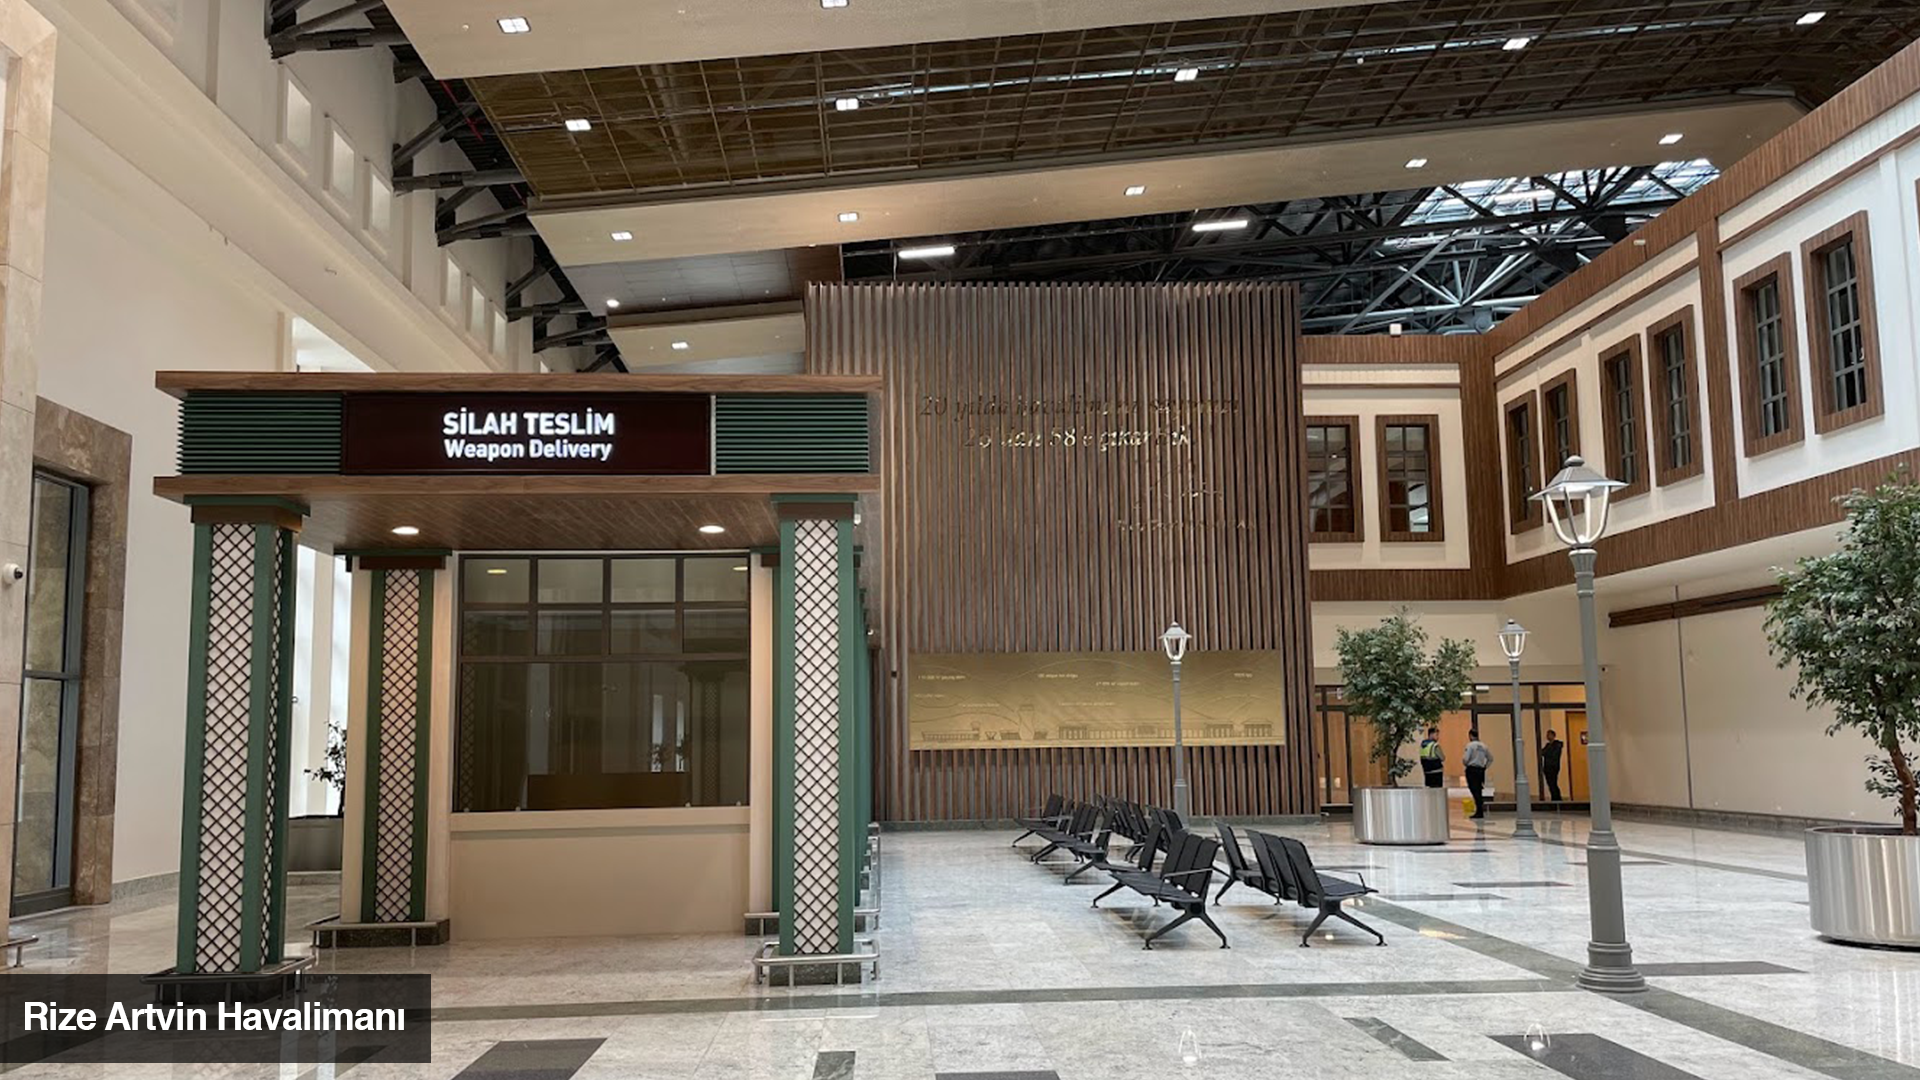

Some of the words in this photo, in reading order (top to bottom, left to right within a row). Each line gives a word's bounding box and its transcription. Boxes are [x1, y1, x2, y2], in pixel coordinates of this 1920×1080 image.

[441, 406, 517, 436] SİLAH
[522, 406, 615, 436] TESLİM
[443, 438, 525, 462] Weapon
[528, 438, 613, 462] Delivery
